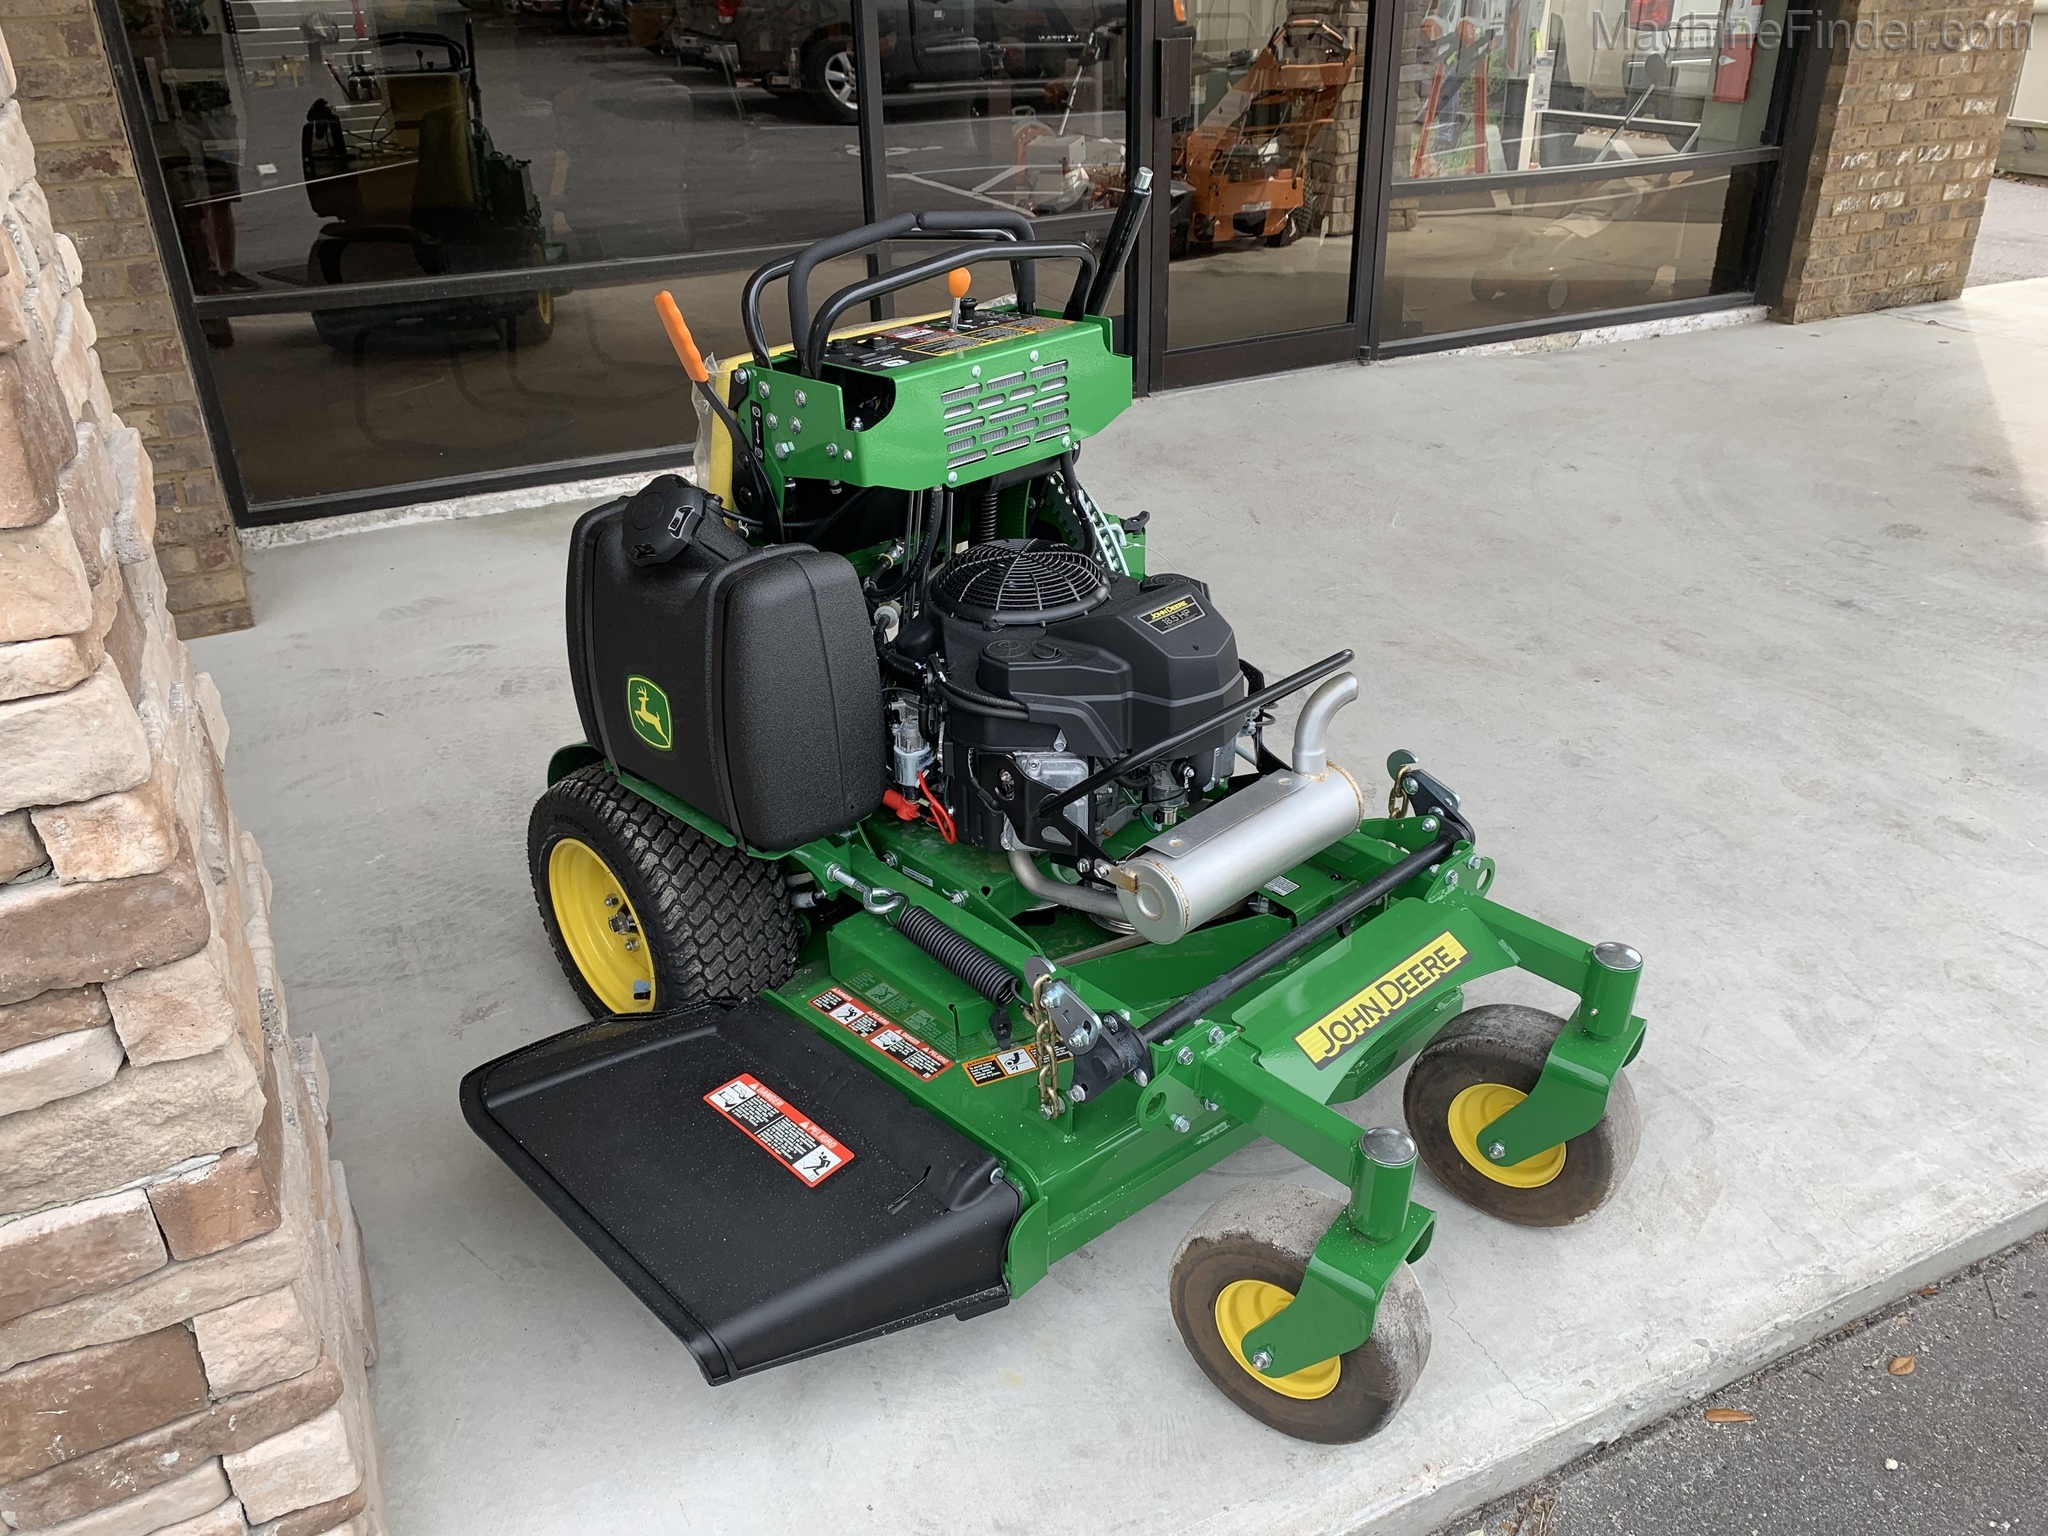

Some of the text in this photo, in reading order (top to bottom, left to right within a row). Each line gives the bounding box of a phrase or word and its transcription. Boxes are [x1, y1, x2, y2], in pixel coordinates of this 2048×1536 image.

[1151, 600, 1188, 619] JOHN DEERE
[1177, 608, 1191, 619] HP
[1317, 945, 1457, 1055] JOHN DEERE
[756, 1087, 785, 1108] DANGER
[807, 1125, 838, 1149] PELIGRO
